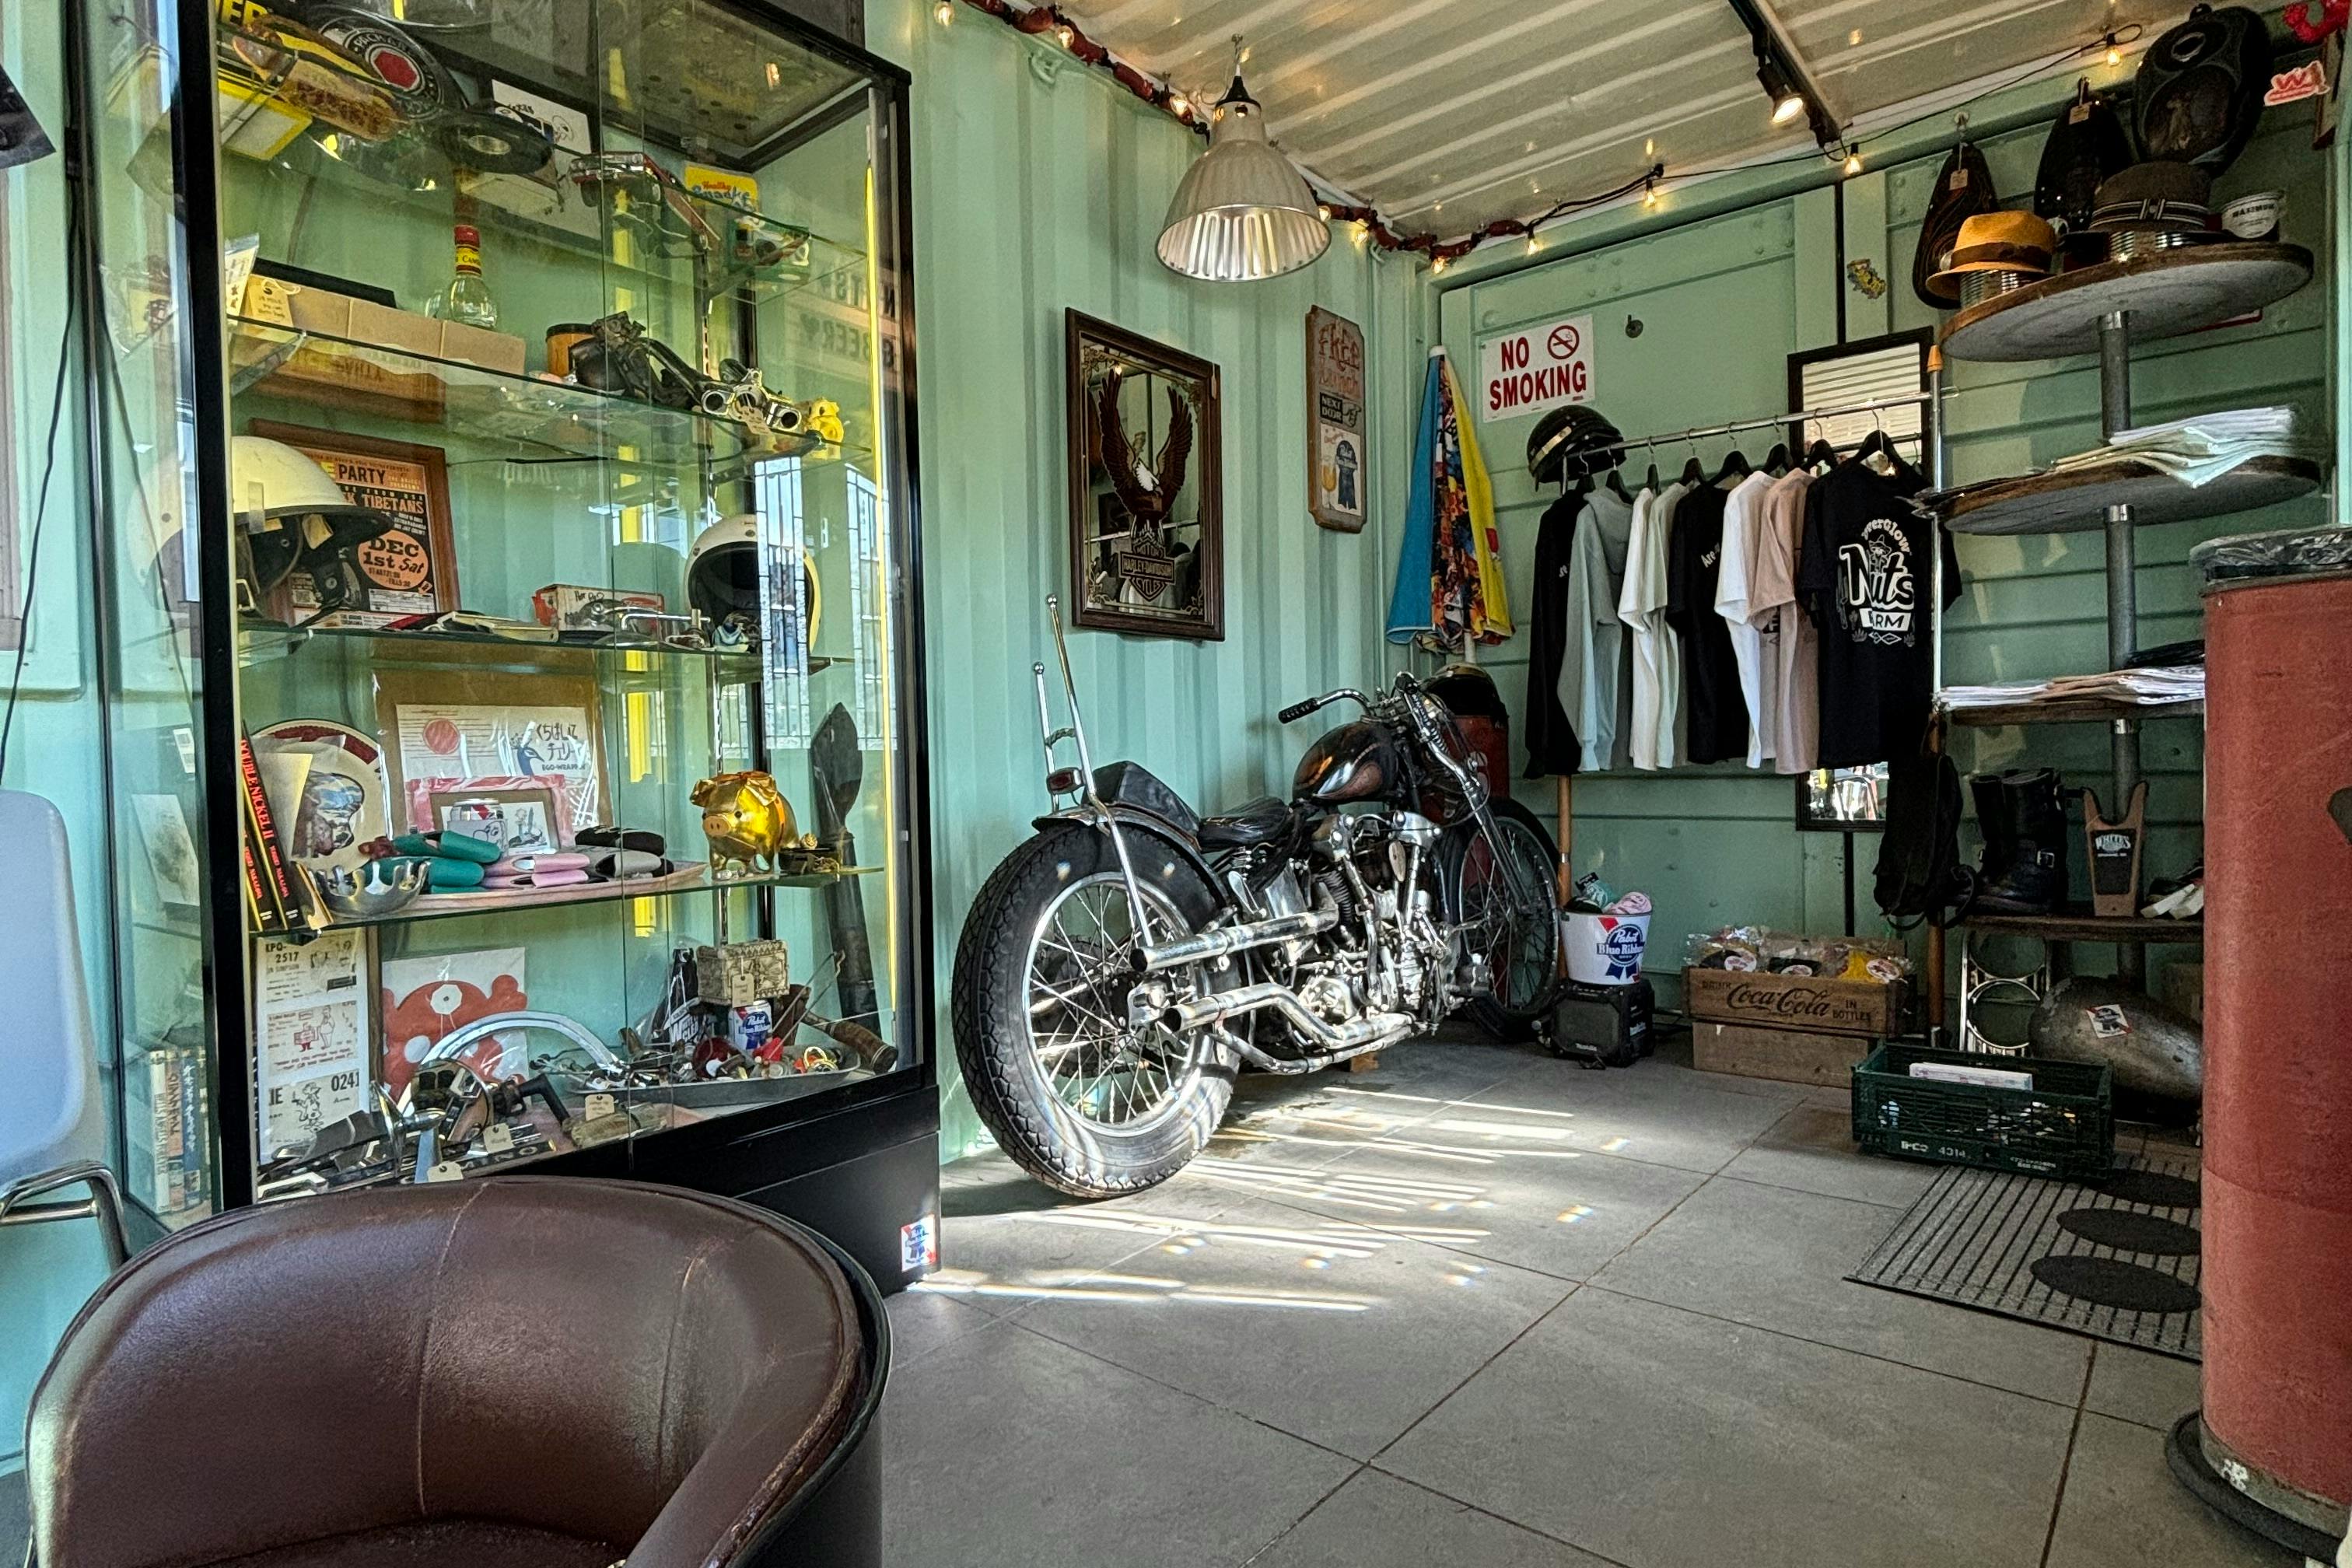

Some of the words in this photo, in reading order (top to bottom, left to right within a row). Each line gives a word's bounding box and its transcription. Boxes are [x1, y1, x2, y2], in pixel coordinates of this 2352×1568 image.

[1501, 337, 1529, 372] NO
[1489, 360, 1587, 411] SMOKING
[1321, 395, 1342, 410] NEXT
[1321, 407, 1342, 422] DOOR
[338, 464, 386, 485] PARTY
[361, 493, 425, 515] TIBETANS
[368, 537, 419, 558] DEC
[363, 551, 395, 569] 1st
[398, 558, 425, 574] Sat
[249, 786, 272, 830] NICKEL
[1613, 929, 1639, 943] Pabst
[275, 951, 299, 964] 2517
[1598, 943, 1621, 955] Blue
[1845, 999, 1857, 1009] IN
